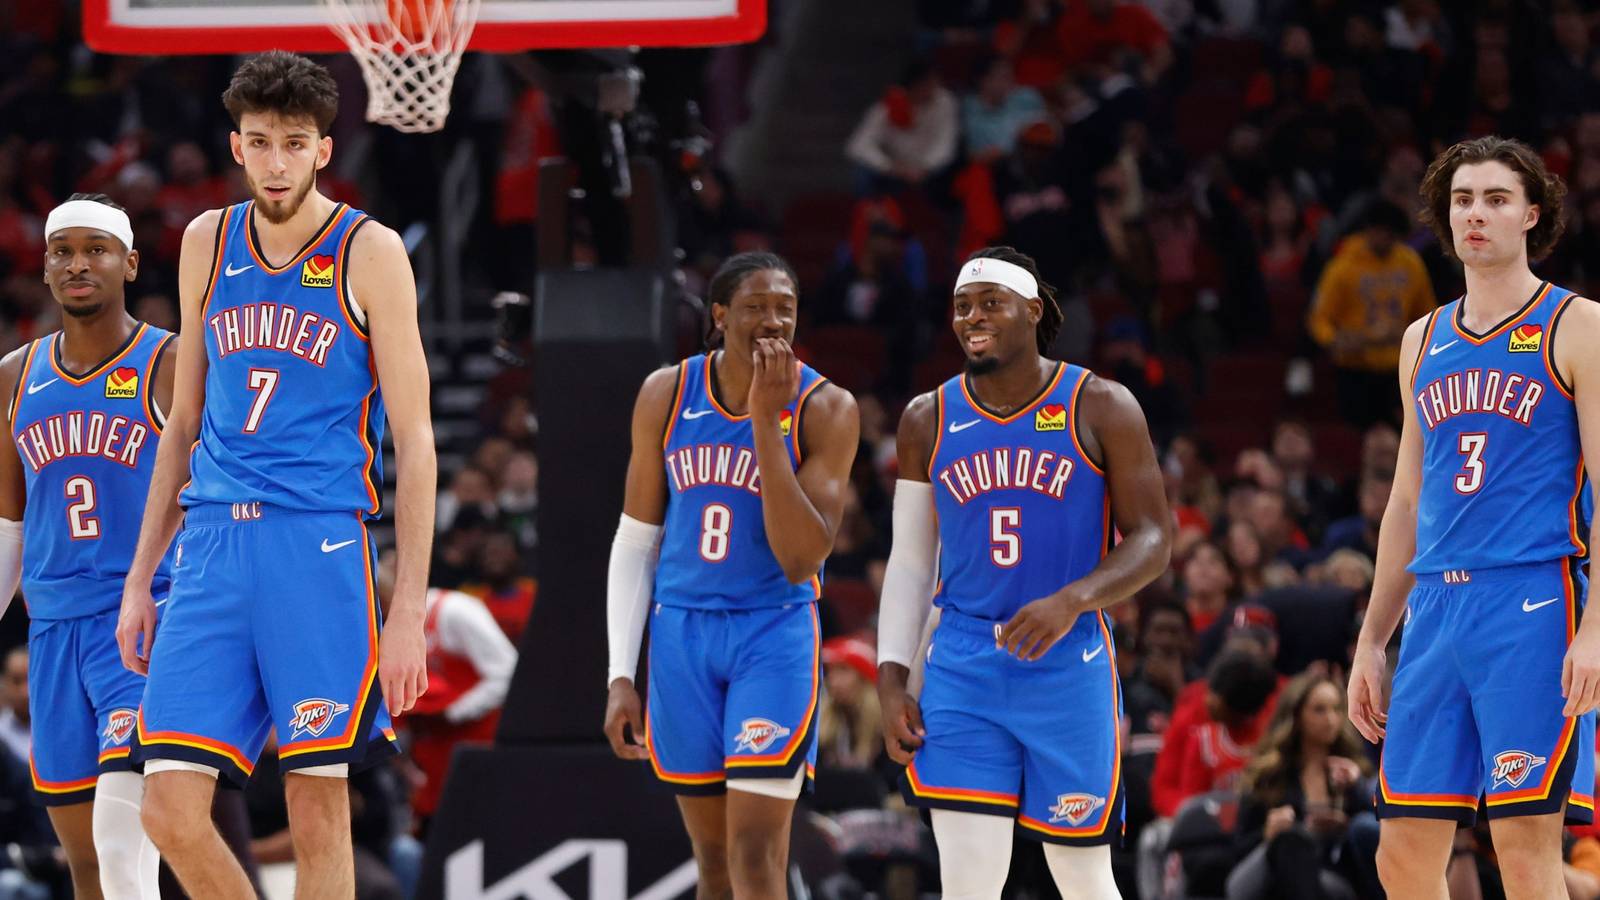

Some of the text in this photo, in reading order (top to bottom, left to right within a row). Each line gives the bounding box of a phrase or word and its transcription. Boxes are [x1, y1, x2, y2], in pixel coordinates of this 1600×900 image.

[303, 275, 331, 285] Love's
[209, 302, 339, 367] THUNDER
[1510, 341, 1538, 350] Love's
[107, 387, 135, 396] Love's
[242, 368, 280, 434] 7
[1417, 369, 1544, 430] THUNDER
[16, 411, 149, 473] THUNDER
[1456, 432, 1487, 494] 3
[667, 445, 761, 495] THUNDE
[939, 448, 1074, 505] THUNDER
[65, 474, 102, 540] 2
[231, 501, 261, 520] OKC
[699, 502, 732, 562] 8
[990, 507, 1021, 567] 5
[1443, 569, 1470, 584] OKC
[107, 715, 130, 738] OKC
[296, 704, 326, 730] OKC
[1497, 757, 1524, 779] OKC
[1058, 800, 1088, 817] OKC
